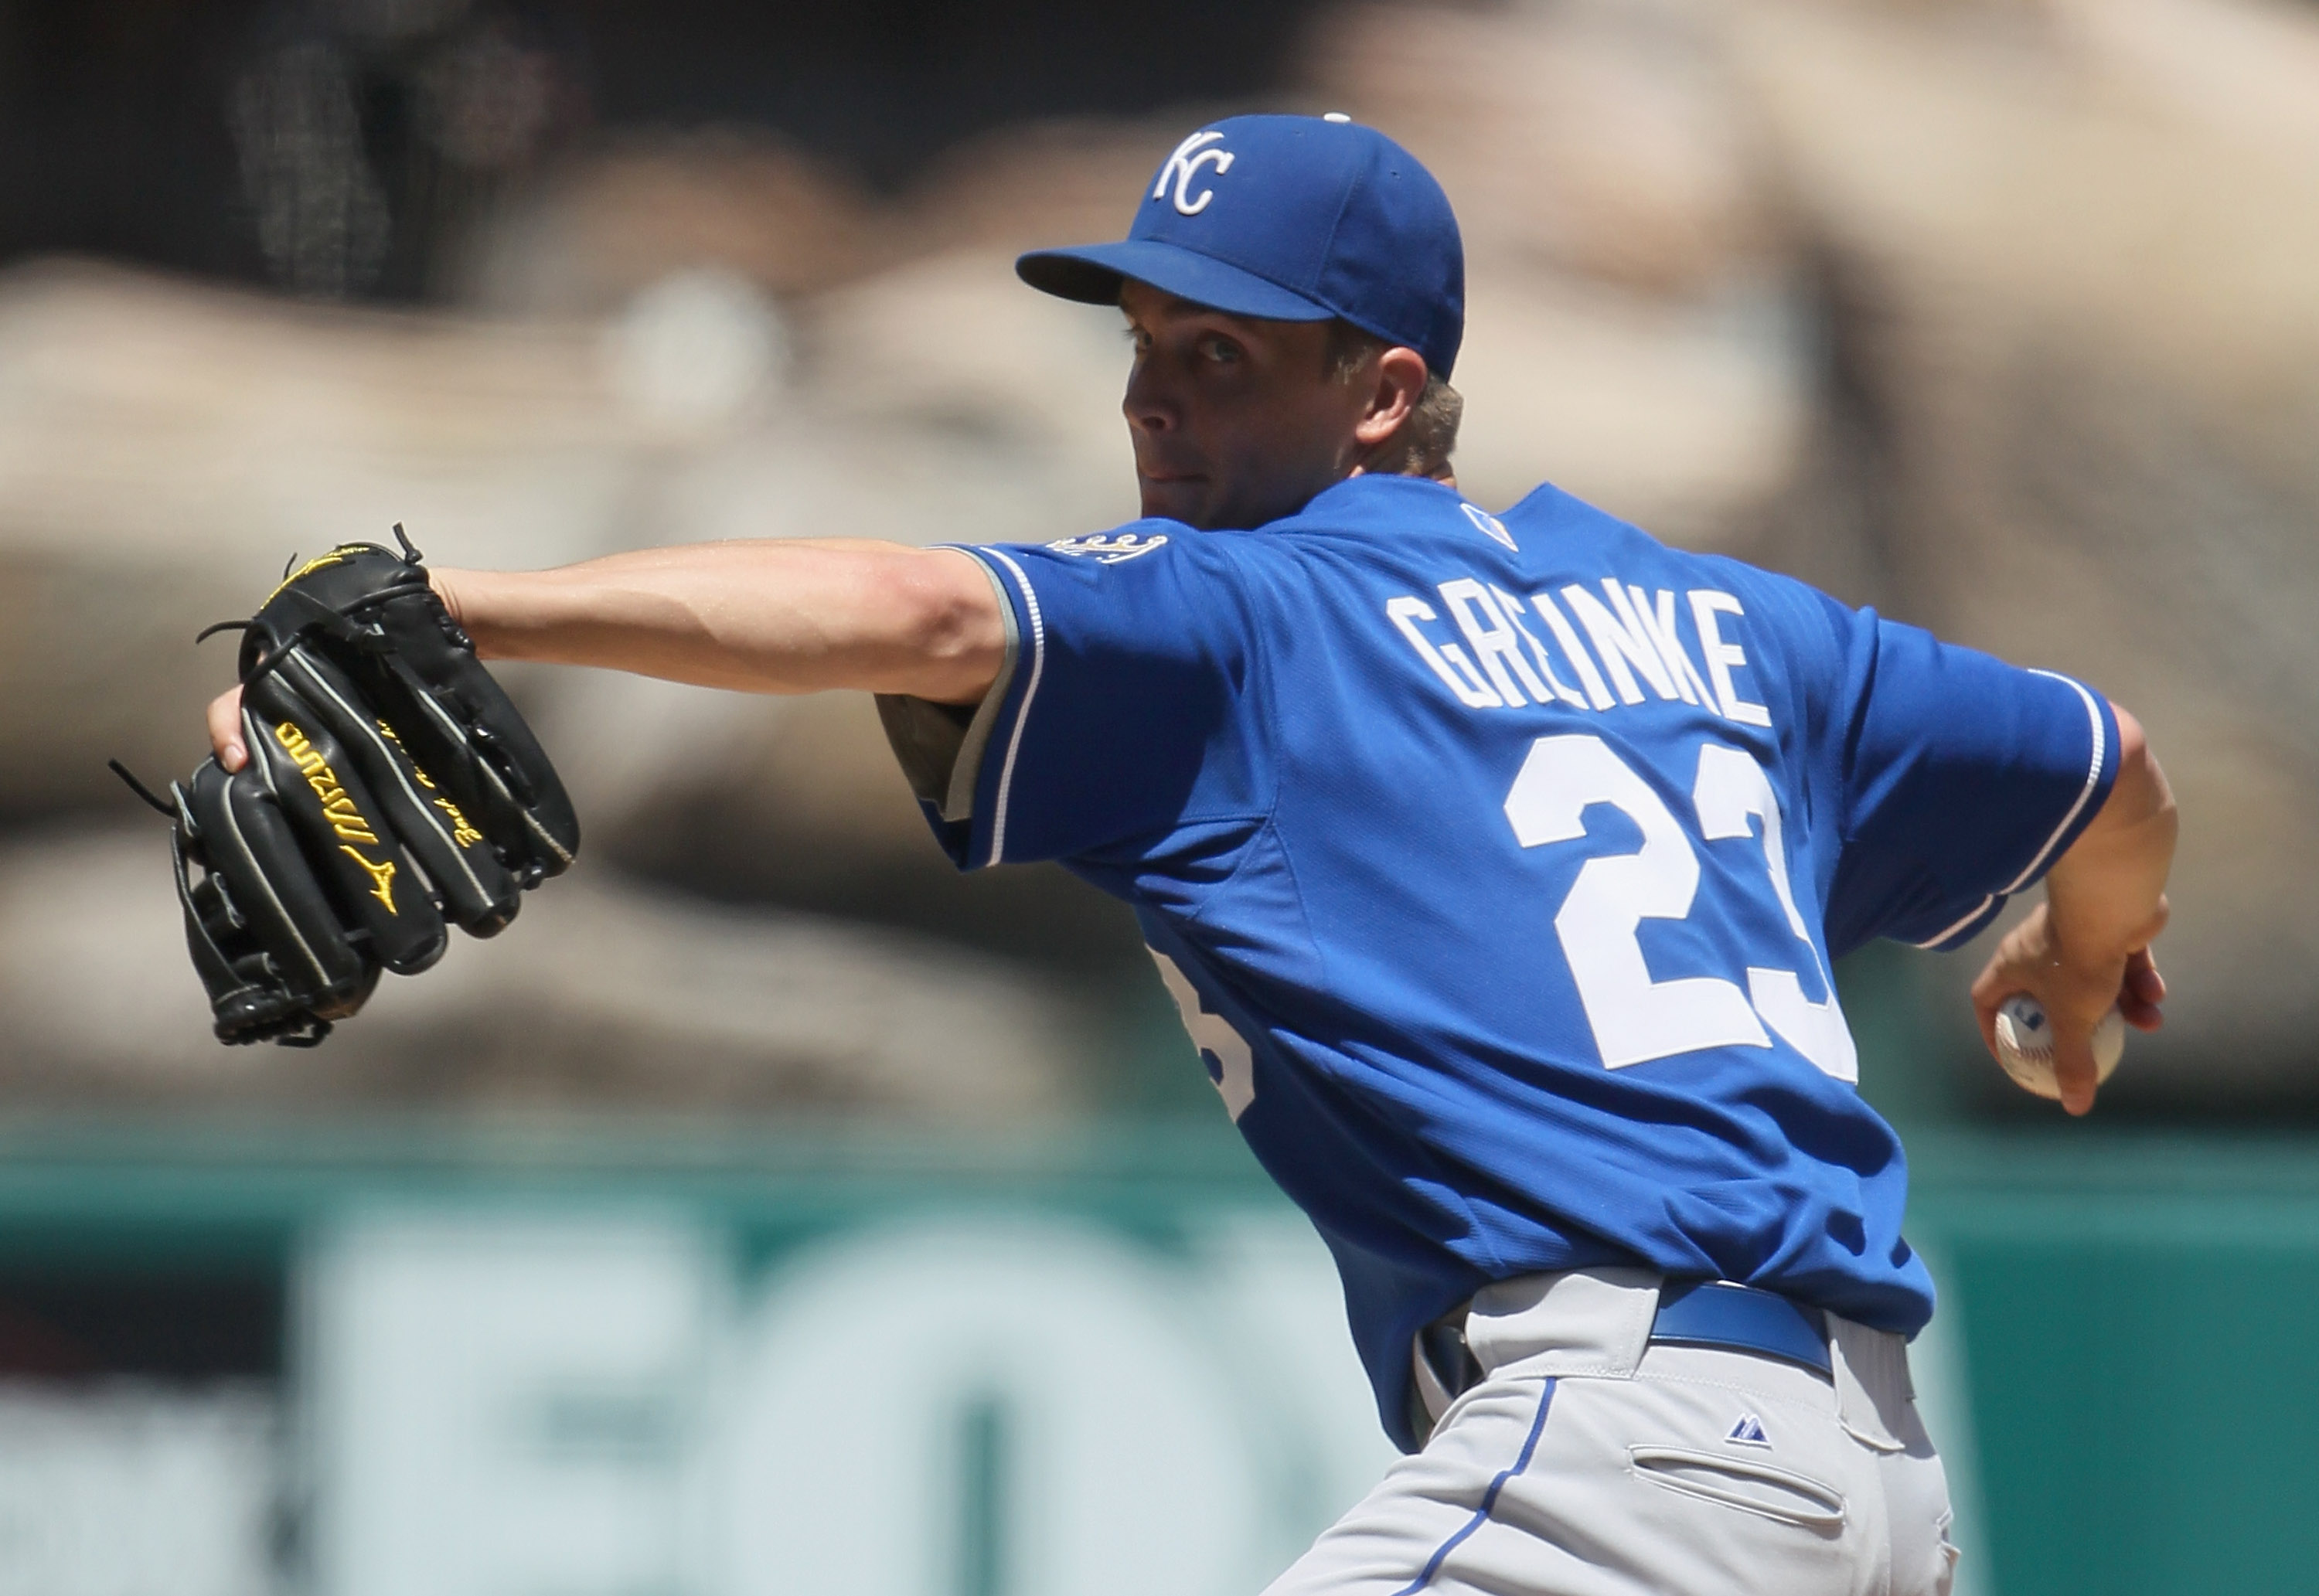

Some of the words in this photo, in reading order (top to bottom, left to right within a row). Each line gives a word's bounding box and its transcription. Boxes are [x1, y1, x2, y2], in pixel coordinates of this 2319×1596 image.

[1153, 131, 1234, 216] KC
[1388, 578, 1772, 727] GREINKE
[1503, 734, 1858, 1086] 23
